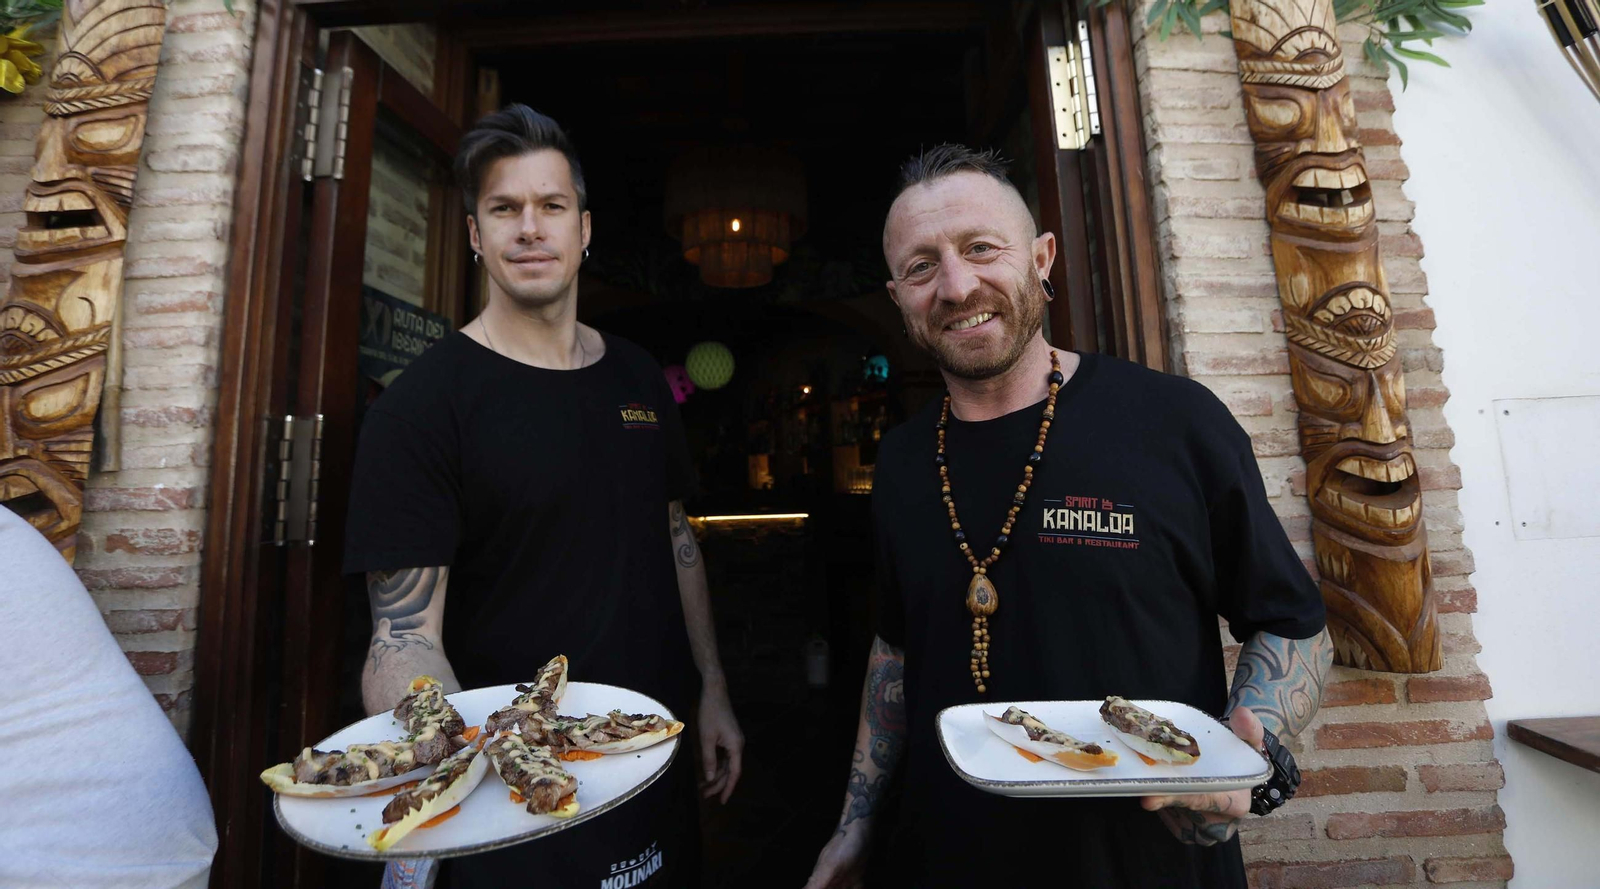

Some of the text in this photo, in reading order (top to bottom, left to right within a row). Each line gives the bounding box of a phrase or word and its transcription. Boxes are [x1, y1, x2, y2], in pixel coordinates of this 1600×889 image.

[393, 308, 425, 335] RUTA
[1065, 495, 1099, 509] SPIRIT
[1042, 508, 1134, 535] KANALOA
[1038, 535, 1055, 544] TIKI
[1056, 537, 1074, 545] BAR
[1084, 538, 1140, 550] RESTAURANT
[600, 850, 663, 889] MOLINARI
